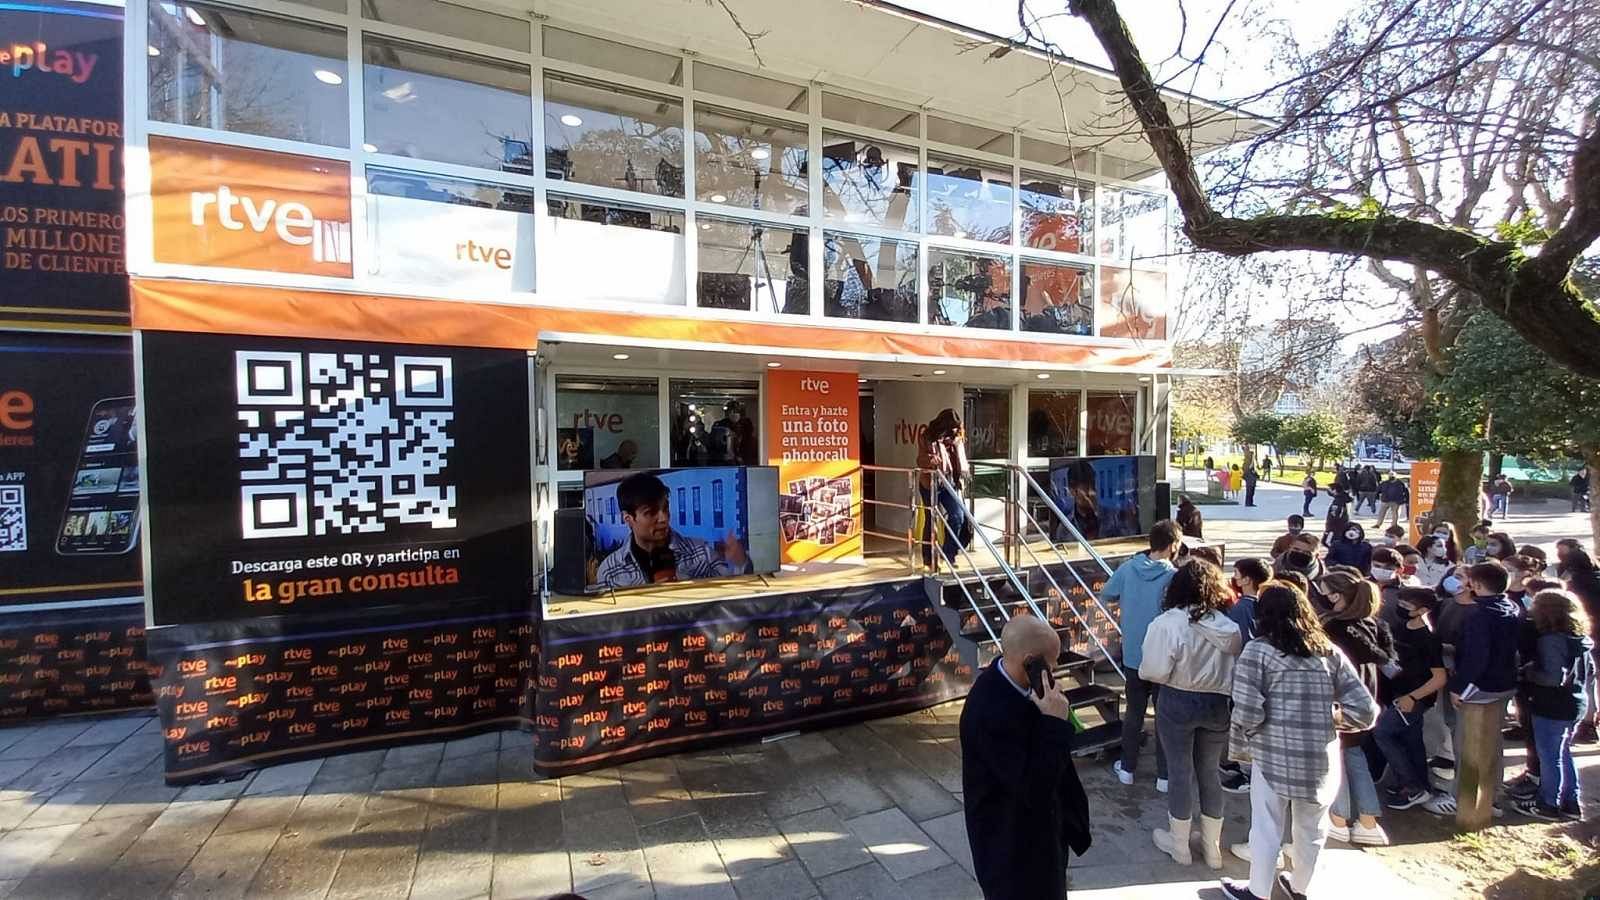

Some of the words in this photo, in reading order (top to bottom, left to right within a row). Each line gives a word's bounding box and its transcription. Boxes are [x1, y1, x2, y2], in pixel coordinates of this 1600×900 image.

[14, 41, 97, 84] play
[16, 113, 124, 138] PLATAFOR
[0, 136, 125, 191] ATI
[0, 206, 28, 224] OS
[191, 185, 314, 245] rtve
[456, 239, 512, 269] rtve
[6, 252, 32, 270] DE
[801, 377, 829, 394] rtve
[782, 405, 810, 416] Entra
[812, 407, 818, 418] y
[821, 405, 848, 416] hazte
[573, 408, 623, 434] rtve
[783, 420, 813, 433] una
[817, 417, 848, 433] foto
[783, 436, 797, 447] en
[802, 434, 848, 447] nuestro
[783, 447, 848, 465] photocall
[232, 559, 302, 575] Descarga
[306, 556, 338, 568] este
[342, 553, 362, 567] QR
[365, 554, 374, 567] y
[378, 548, 440, 565] participa
[444, 548, 460, 559] en
[243, 579, 272, 602] la
[278, 577, 343, 604] gran
[349, 565, 459, 593] consulta
[433, 633, 458, 645] play
[472, 627, 496, 639] rtve
[339, 643, 366, 657] play
[383, 638, 408, 650] rtve
[495, 643, 517, 653] rtve
[284, 648, 312, 660] rtve
[408, 652, 432, 664] rtve
[456, 649, 480, 662] play
[177, 659, 208, 672] rtve
[237, 654, 267, 668] play
[365, 660, 391, 673] play
[310, 665, 337, 676] rtve
[472, 663, 496, 674] rtve
[266, 671, 293, 683] play
[384, 674, 409, 686] rtve
[434, 669, 458, 682] play
[205, 676, 237, 690] rtve
[341, 681, 367, 694] play
[495, 678, 518, 688] rtve
[286, 686, 314, 697] rtve
[408, 688, 433, 699] rtve
[456, 684, 480, 697] play
[239, 692, 269, 708] play
[313, 701, 341, 712] rtve
[367, 695, 392, 709] play
[472, 697, 496, 709] rtve
[176, 701, 208, 714] rtve
[434, 705, 459, 718] play
[268, 707, 296, 722] play
[385, 708, 411, 721] rtve
[207, 715, 240, 729] rtve
[288, 721, 316, 734] rtve
[343, 717, 369, 731] play
[241, 730, 271, 746] play
[178, 740, 210, 755] rtve
